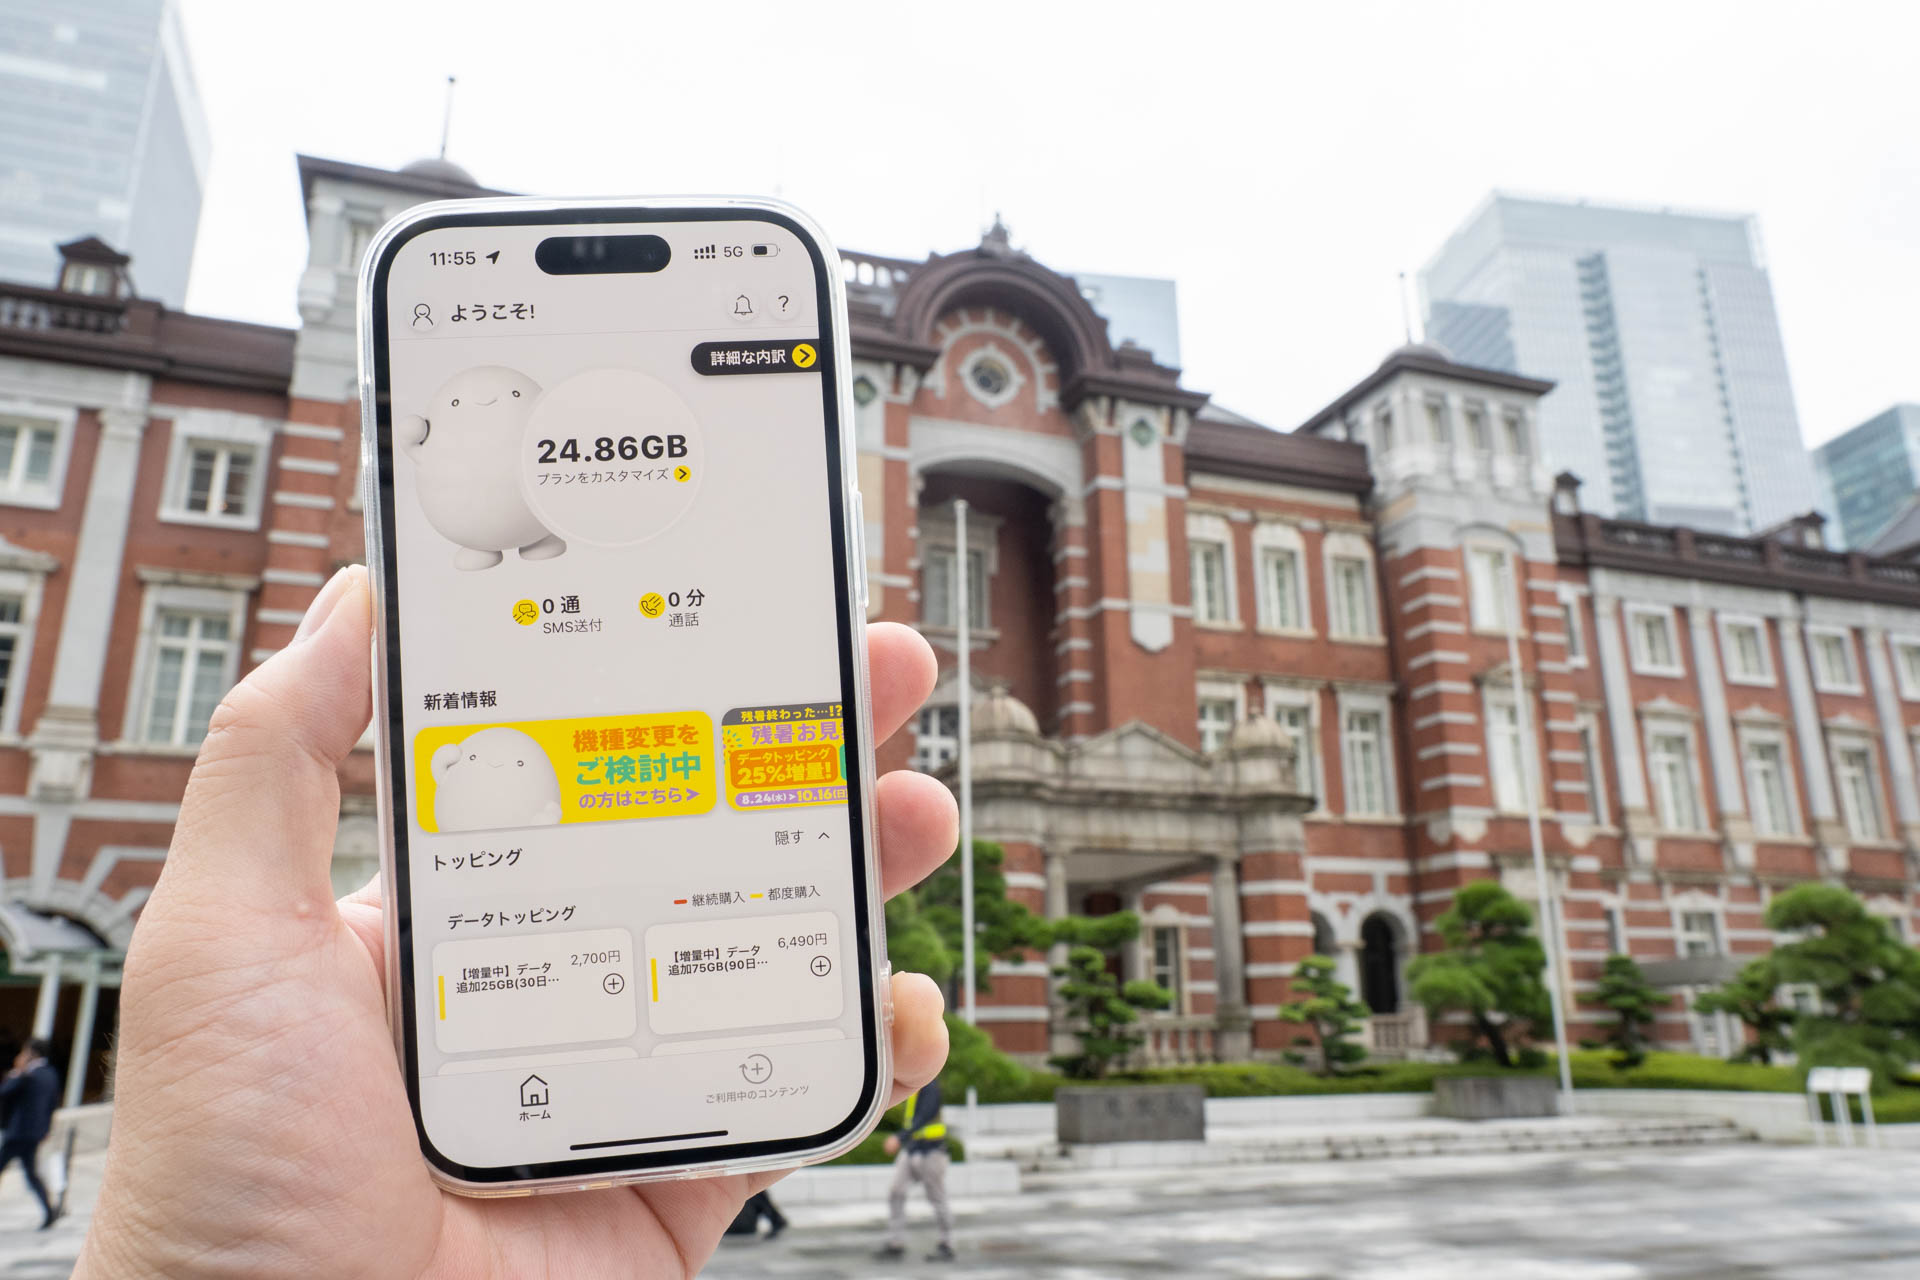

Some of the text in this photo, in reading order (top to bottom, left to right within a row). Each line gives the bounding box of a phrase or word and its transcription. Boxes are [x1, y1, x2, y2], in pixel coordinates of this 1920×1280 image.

[429, 250, 477, 267] 11:55
[723, 245, 744, 258] 5G
[450, 302, 535, 323] ようこそ!
[710, 349, 786, 366] 詳細な内訳
[536, 433, 689, 465] 24.86GB
[537, 467, 669, 486] プランをカスタマイズ
[542, 595, 581, 615] 0 通
[667, 588, 706, 608] 0 分
[542, 617, 603, 635] SMS送付
[668, 611, 700, 628] 通話
[423, 689, 498, 712] 新着情報
[573, 724, 699, 753] 機種変更を
[751, 721, 845, 745] 残暑お見
[737, 748, 831, 765] データトッピング
[576, 751, 701, 785] ご検討中
[737, 761, 832, 785] 25%増量!
[774, 829, 805, 846] 隠す
[433, 847, 523, 872] トッピング
[691, 891, 746, 908] 継続購入
[767, 885, 821, 901] 都度購入
[447, 904, 577, 931] データトッピング
[777, 932, 828, 950] 6,490円
[570, 949, 622, 967] 2,700円
[705, 1084, 810, 1105] ご利用中のコンテンツ
[518, 1109, 552, 1123] ホーム
